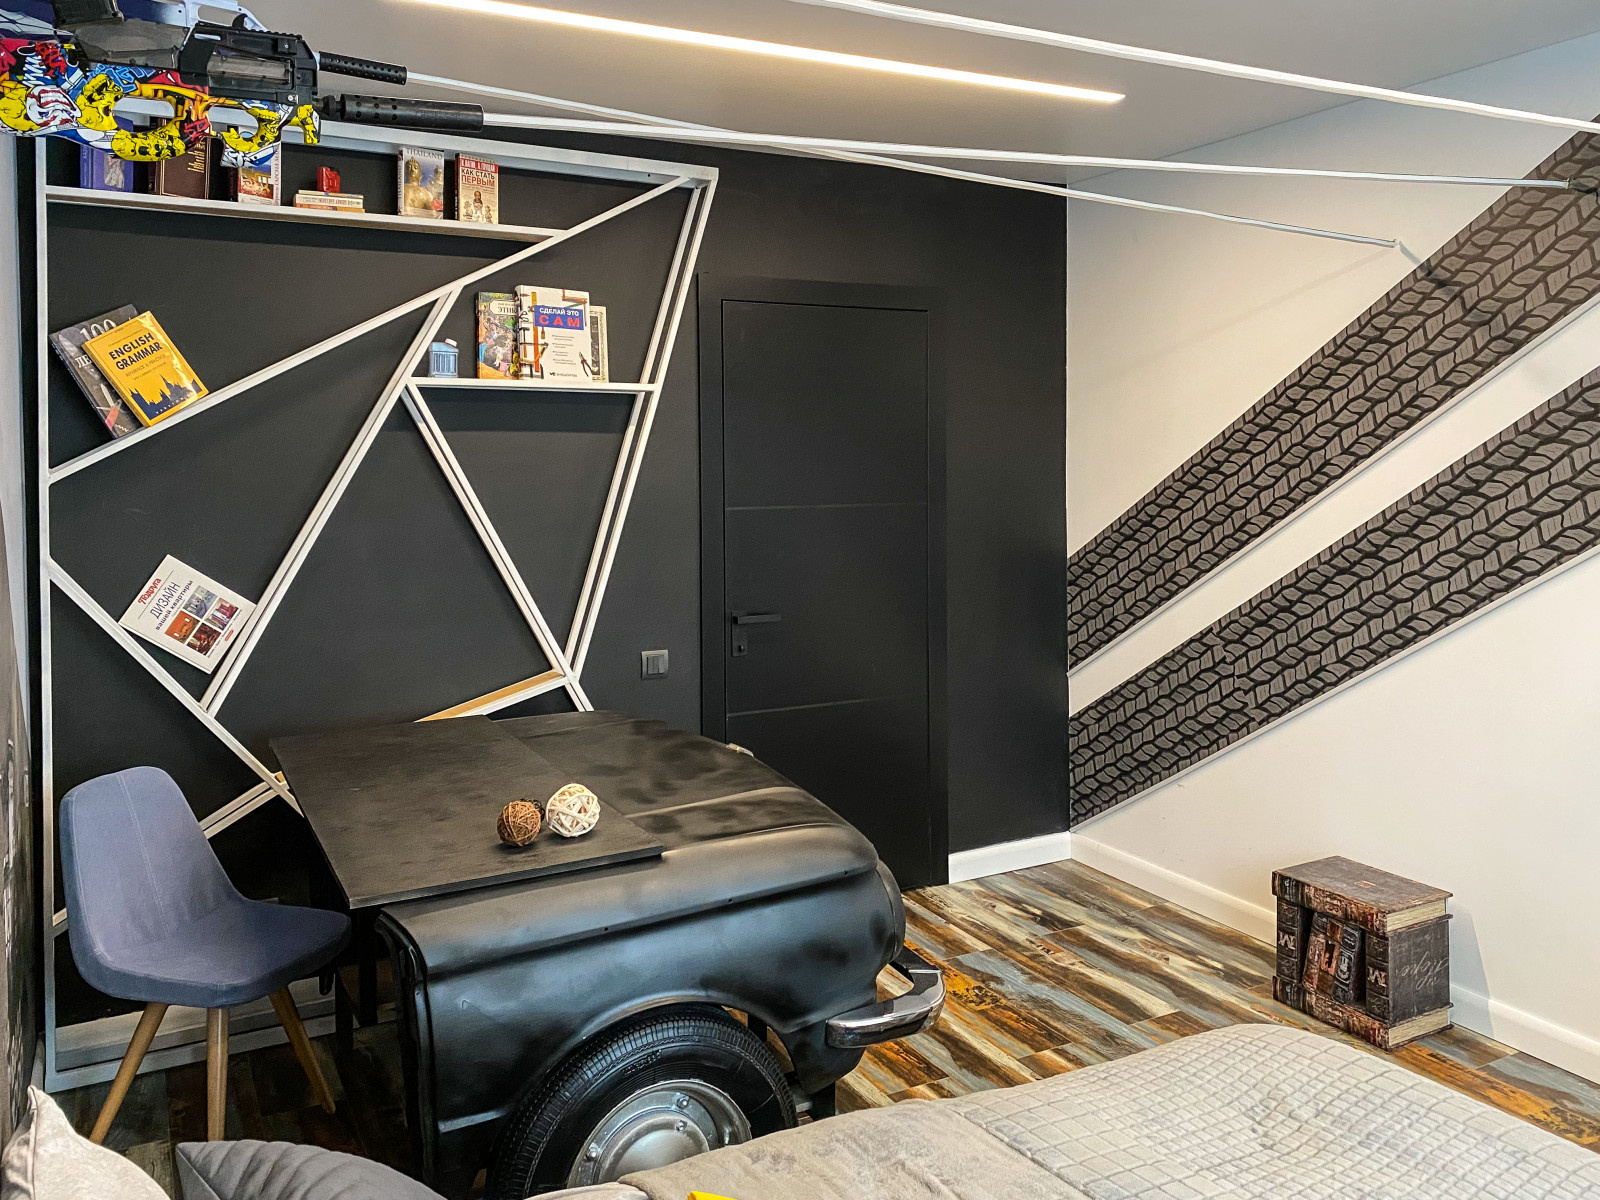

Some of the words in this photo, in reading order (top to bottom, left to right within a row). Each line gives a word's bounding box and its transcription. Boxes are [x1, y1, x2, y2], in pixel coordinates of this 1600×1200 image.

[406, 148, 443, 159] THAILAND
[461, 168, 474, 176] КАК
[475, 170, 495, 180] СТАТЬ
[461, 174, 495, 187] ПЕРВЫМ
[539, 306, 566, 316] СДЕЛАЙ
[566, 309, 580, 317] ЭТО
[108, 332, 155, 361] ENGLISH
[115, 341, 163, 371] GRAMMAR
[137, 578, 162, 605] Подруга
[149, 581, 181, 619] ДИЗАЙН
[155, 610, 172, 631] вашей
[171, 580, 193, 610] квартиры
